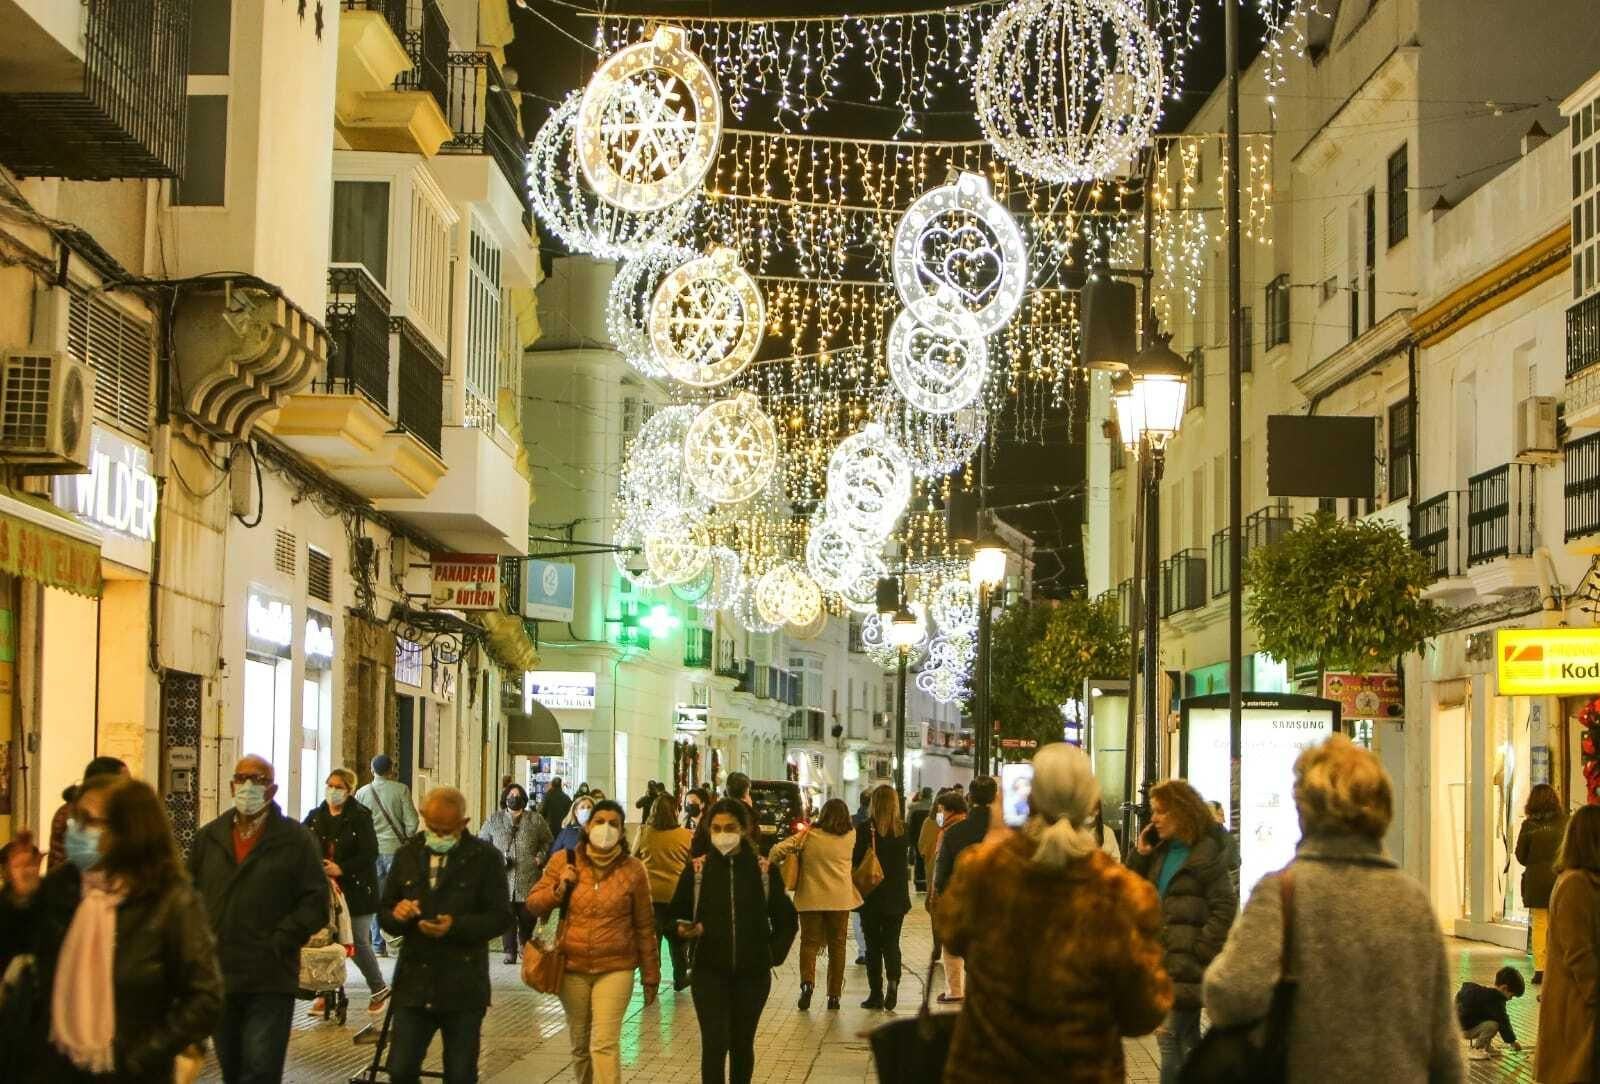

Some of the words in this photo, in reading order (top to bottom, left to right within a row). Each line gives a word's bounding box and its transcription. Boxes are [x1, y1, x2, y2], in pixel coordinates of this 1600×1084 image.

[434, 564, 496, 583] PANADERIA
[456, 589, 495, 606] BUTRON
[1561, 662, 1600, 679] Kod
[1272, 720, 1325, 730] SAMSUNG
